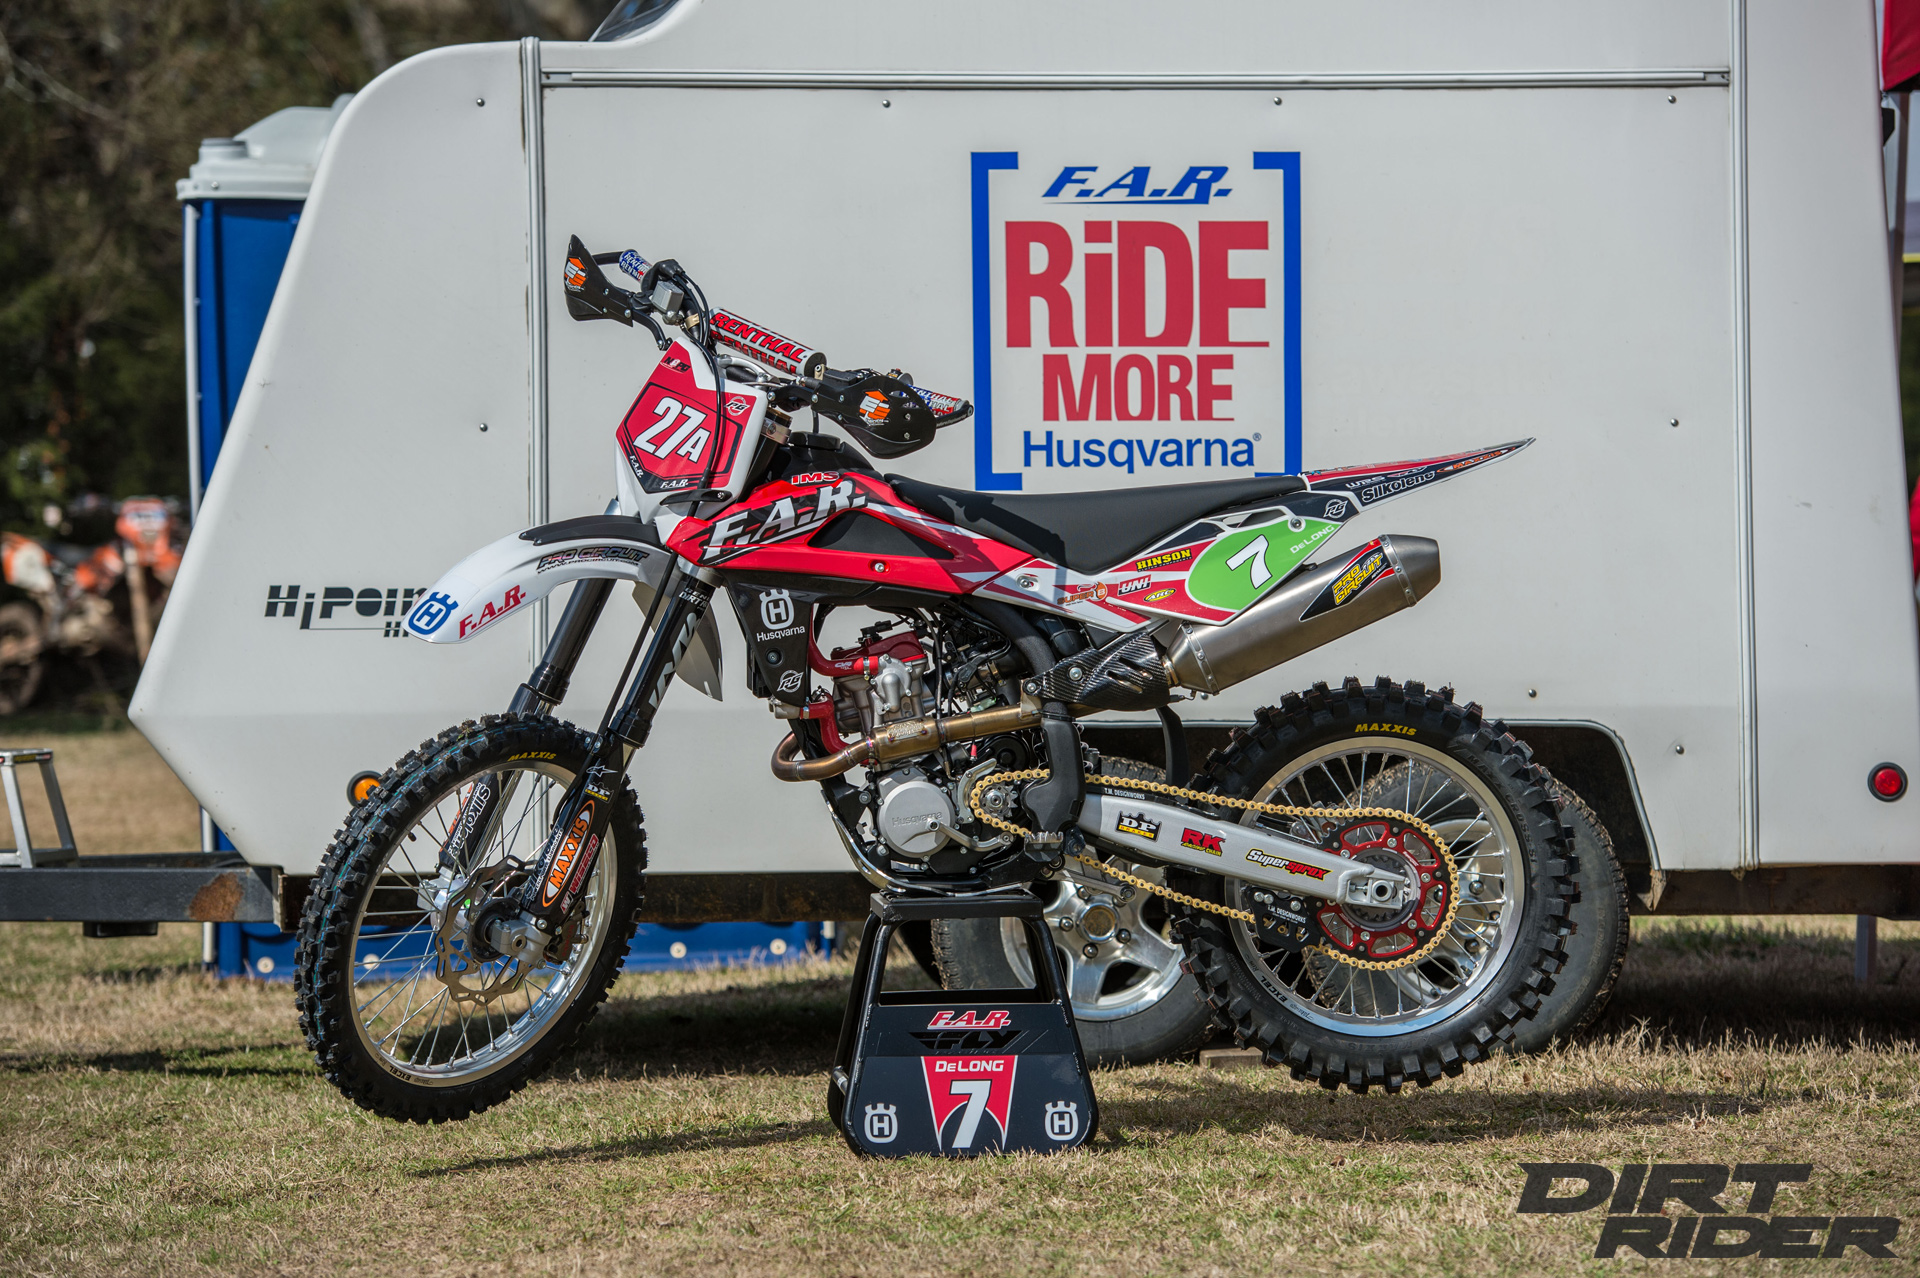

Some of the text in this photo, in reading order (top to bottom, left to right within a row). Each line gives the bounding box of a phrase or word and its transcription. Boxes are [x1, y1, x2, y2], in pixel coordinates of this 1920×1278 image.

[1041, 166, 1233, 204] F.A.R.
[1005, 220, 1270, 348] RiDE
[709, 312, 806, 364] RENTHAL
[1042, 354, 1235, 421] MORE
[633, 396, 711, 464] 27A
[659, 478, 689, 489] F.A.R.
[791, 471, 840, 485] IMS
[701, 480, 867, 561] F.A.R.
[536, 546, 651, 570] PRO CIRCUIT
[1136, 549, 1191, 570] HINSON
[1226, 534, 1273, 590] 7
[1121, 577, 1149, 593] UNI
[1332, 564, 1360, 595] PRO
[1335, 554, 1383, 605] CIRCUIT
[1057, 590, 1095, 605] SUPER
[1147, 589, 1172, 601] ARC
[459, 584, 546, 640] F.A.R.
[756, 625, 806, 642] Husqvarna
[1354, 722, 1417, 736] MAXXIS
[507, 751, 557, 762] MAXXIS
[1120, 815, 1157, 833] DP
[550, 817, 588, 889] MAXXIS
[1181, 827, 1226, 853] RK
[569, 833, 599, 894] WISECO
[1246, 849, 1327, 879] Supersprox
[1259, 974, 1289, 1003] EXCEL
[928, 1010, 1012, 1029] F.A.R.
[389, 1065, 412, 1081] EXCEL
[935, 1060, 1004, 1073] DeLONG
[950, 1079, 992, 1149] 7
